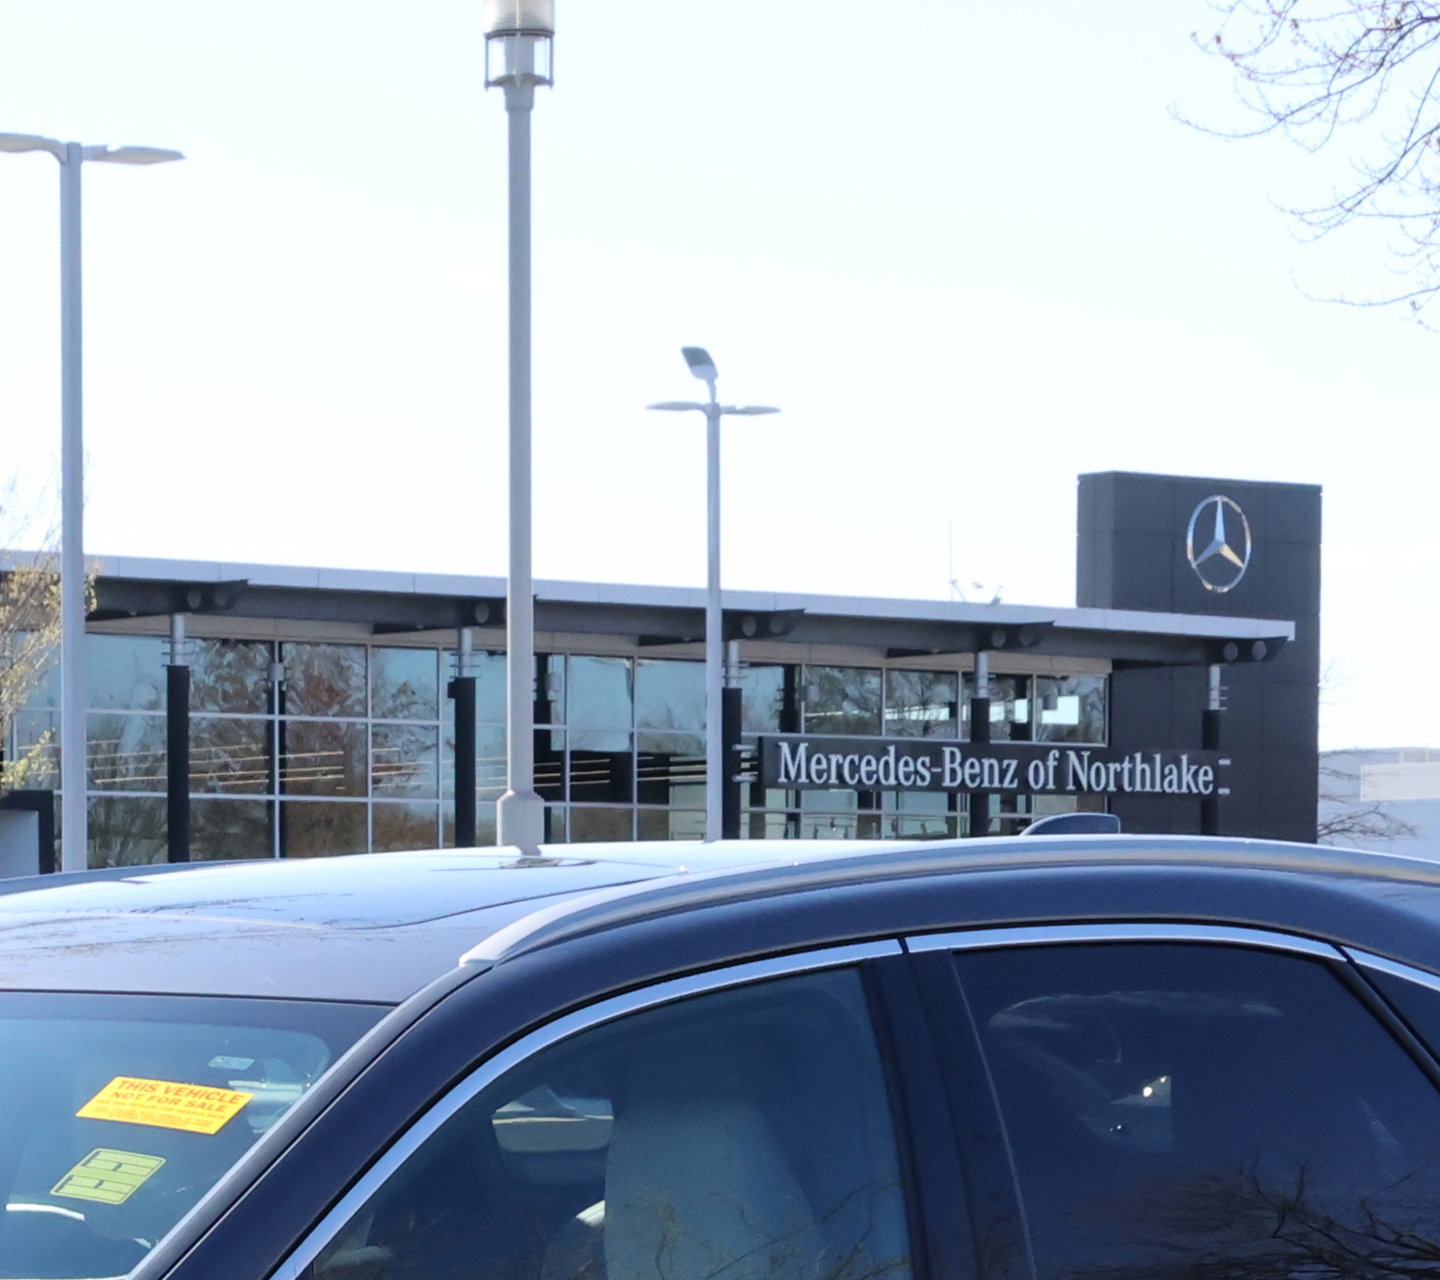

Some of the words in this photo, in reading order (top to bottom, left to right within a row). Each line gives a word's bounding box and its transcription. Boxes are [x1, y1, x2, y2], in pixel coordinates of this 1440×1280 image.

[778, 741, 1018, 788] Mercedes-Benz
[1028, 749, 1060, 790] of
[1066, 750, 1215, 794] Northlake
[109, 1091, 145, 1101] NOT
[148, 1095, 182, 1106] FOR
[184, 1100, 230, 1113] SALE
[118, 1080, 158, 1093] THIS
[164, 1085, 246, 1104] VEHICLE
